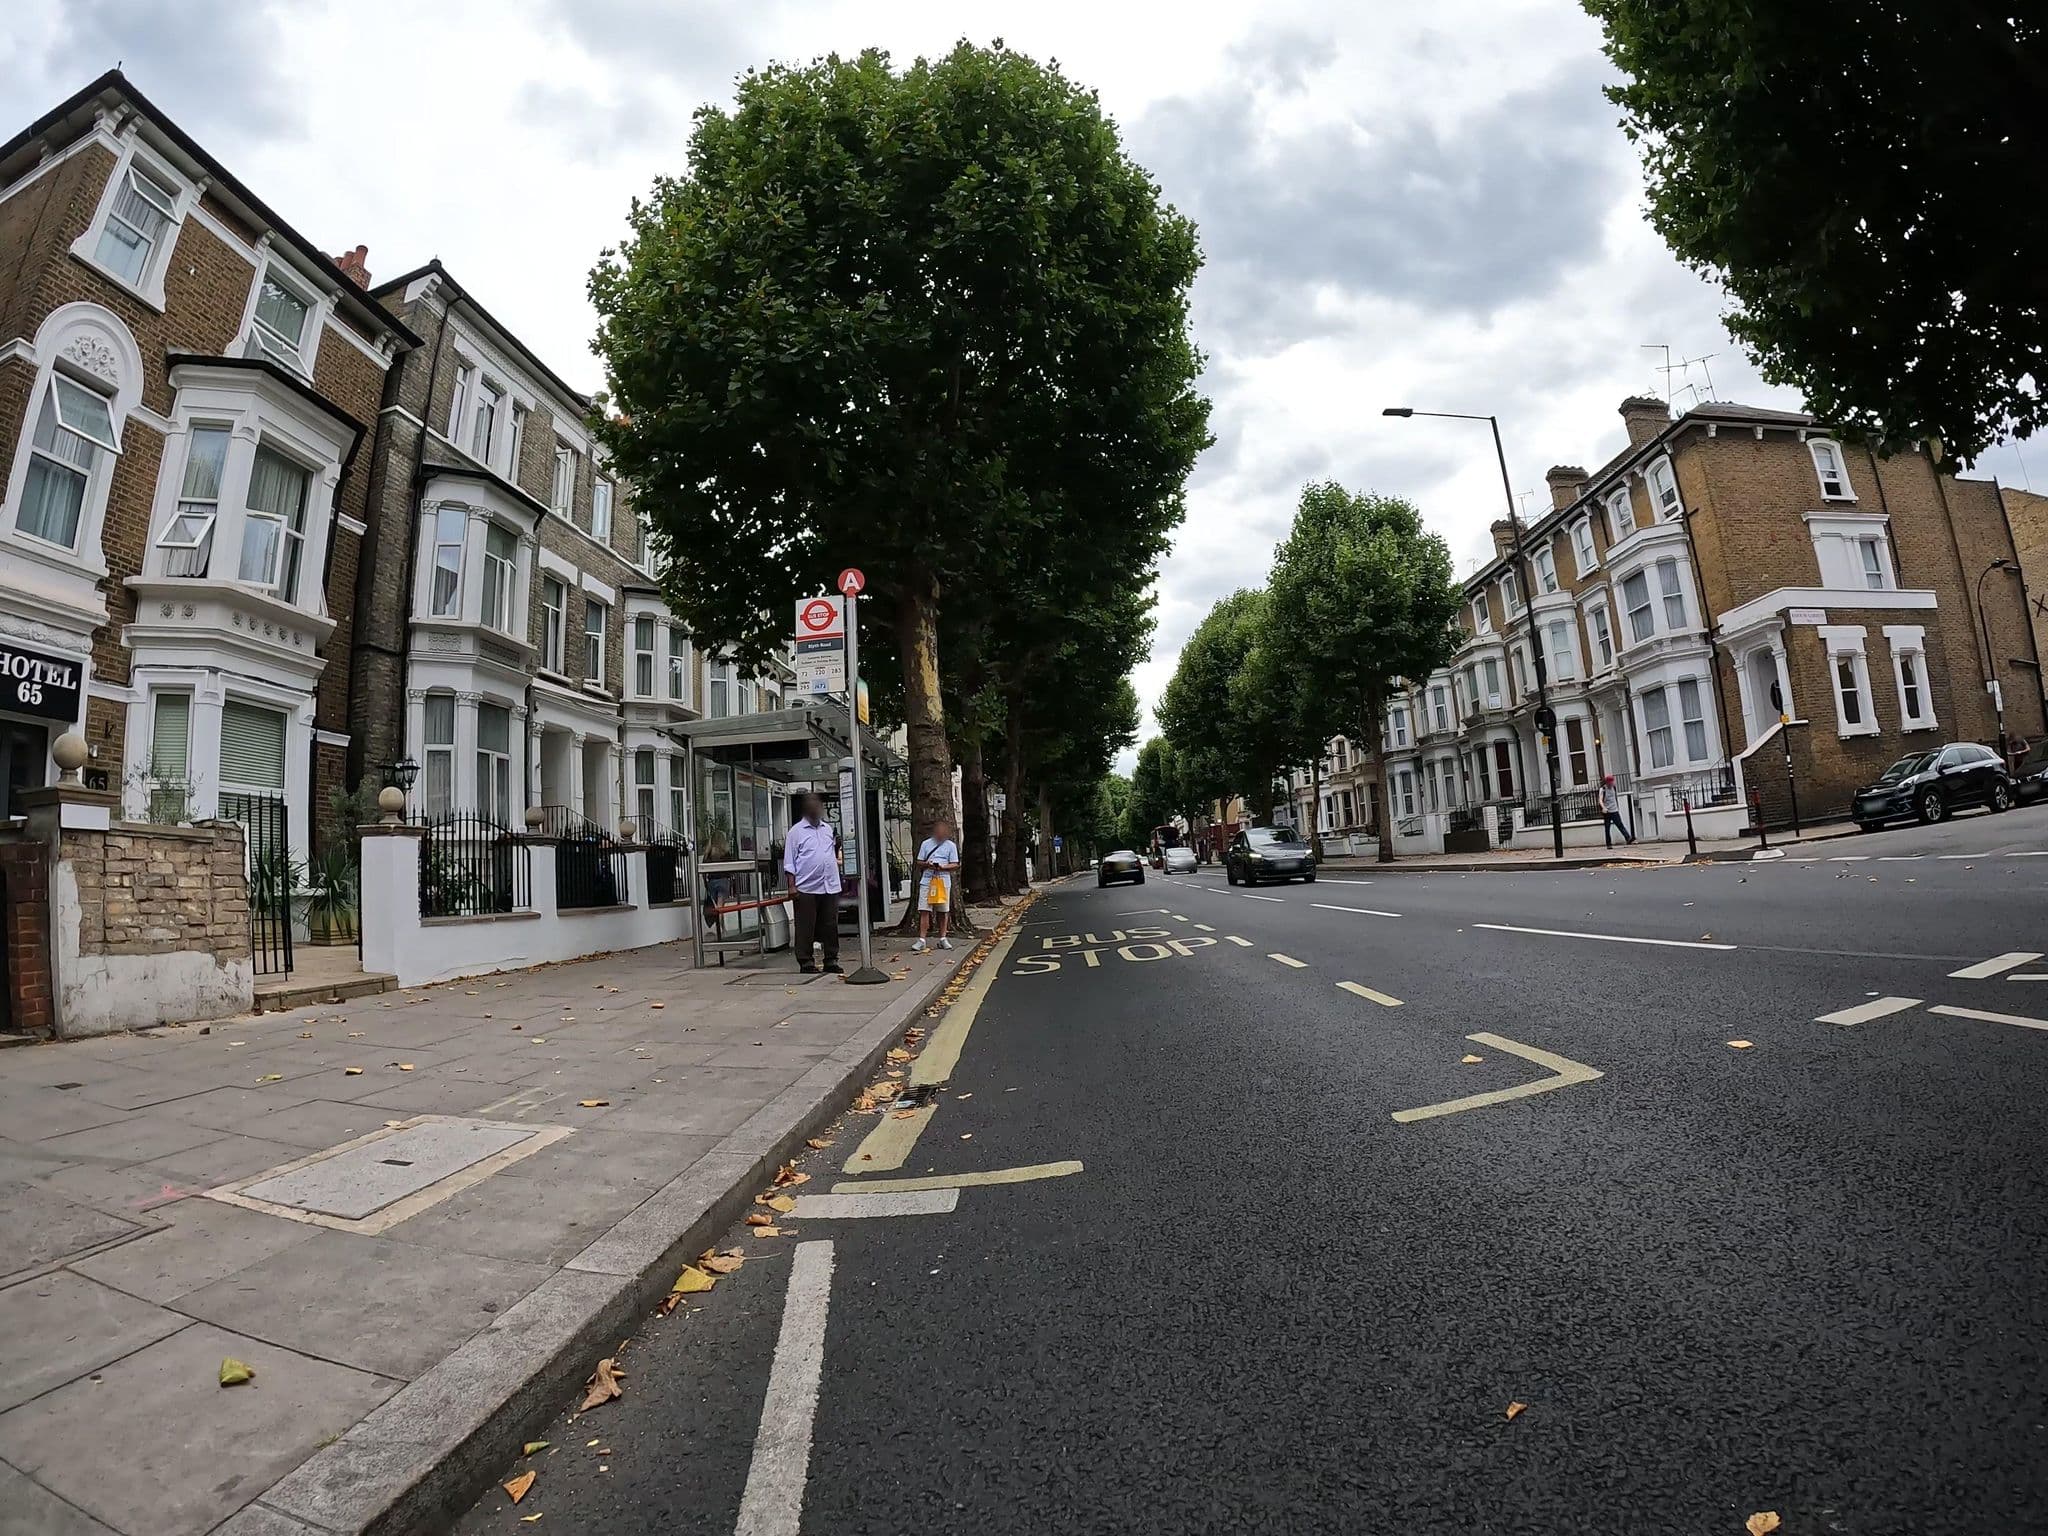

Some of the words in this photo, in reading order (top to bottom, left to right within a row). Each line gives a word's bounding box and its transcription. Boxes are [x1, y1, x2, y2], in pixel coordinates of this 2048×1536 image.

[842, 571, 861, 592] A
[0, 651, 77, 690] HOTEL
[17, 681, 43, 705] 65
[1042, 926, 1172, 950] BUS
[1012, 936, 1218, 976] STOP
